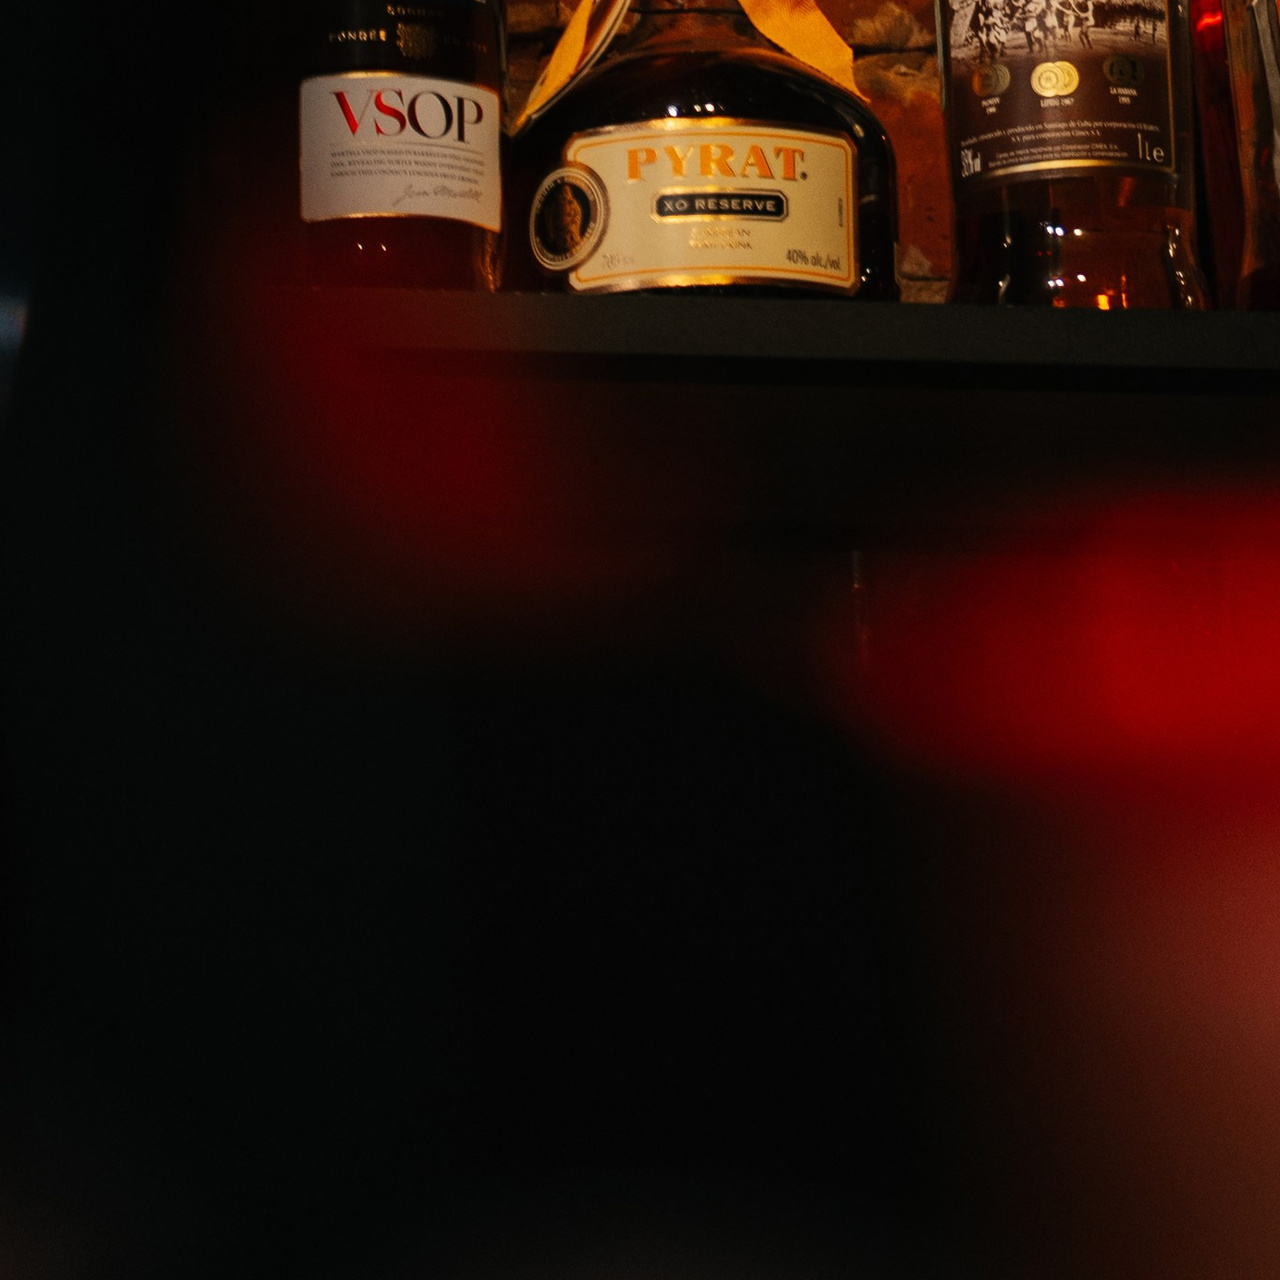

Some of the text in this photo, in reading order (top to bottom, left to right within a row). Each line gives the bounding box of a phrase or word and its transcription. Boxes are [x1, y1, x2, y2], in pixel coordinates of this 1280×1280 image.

[329, 88, 485, 145] VSOP
[626, 143, 805, 182] PYRAT
[664, 198, 778, 214] XO RESERVE
